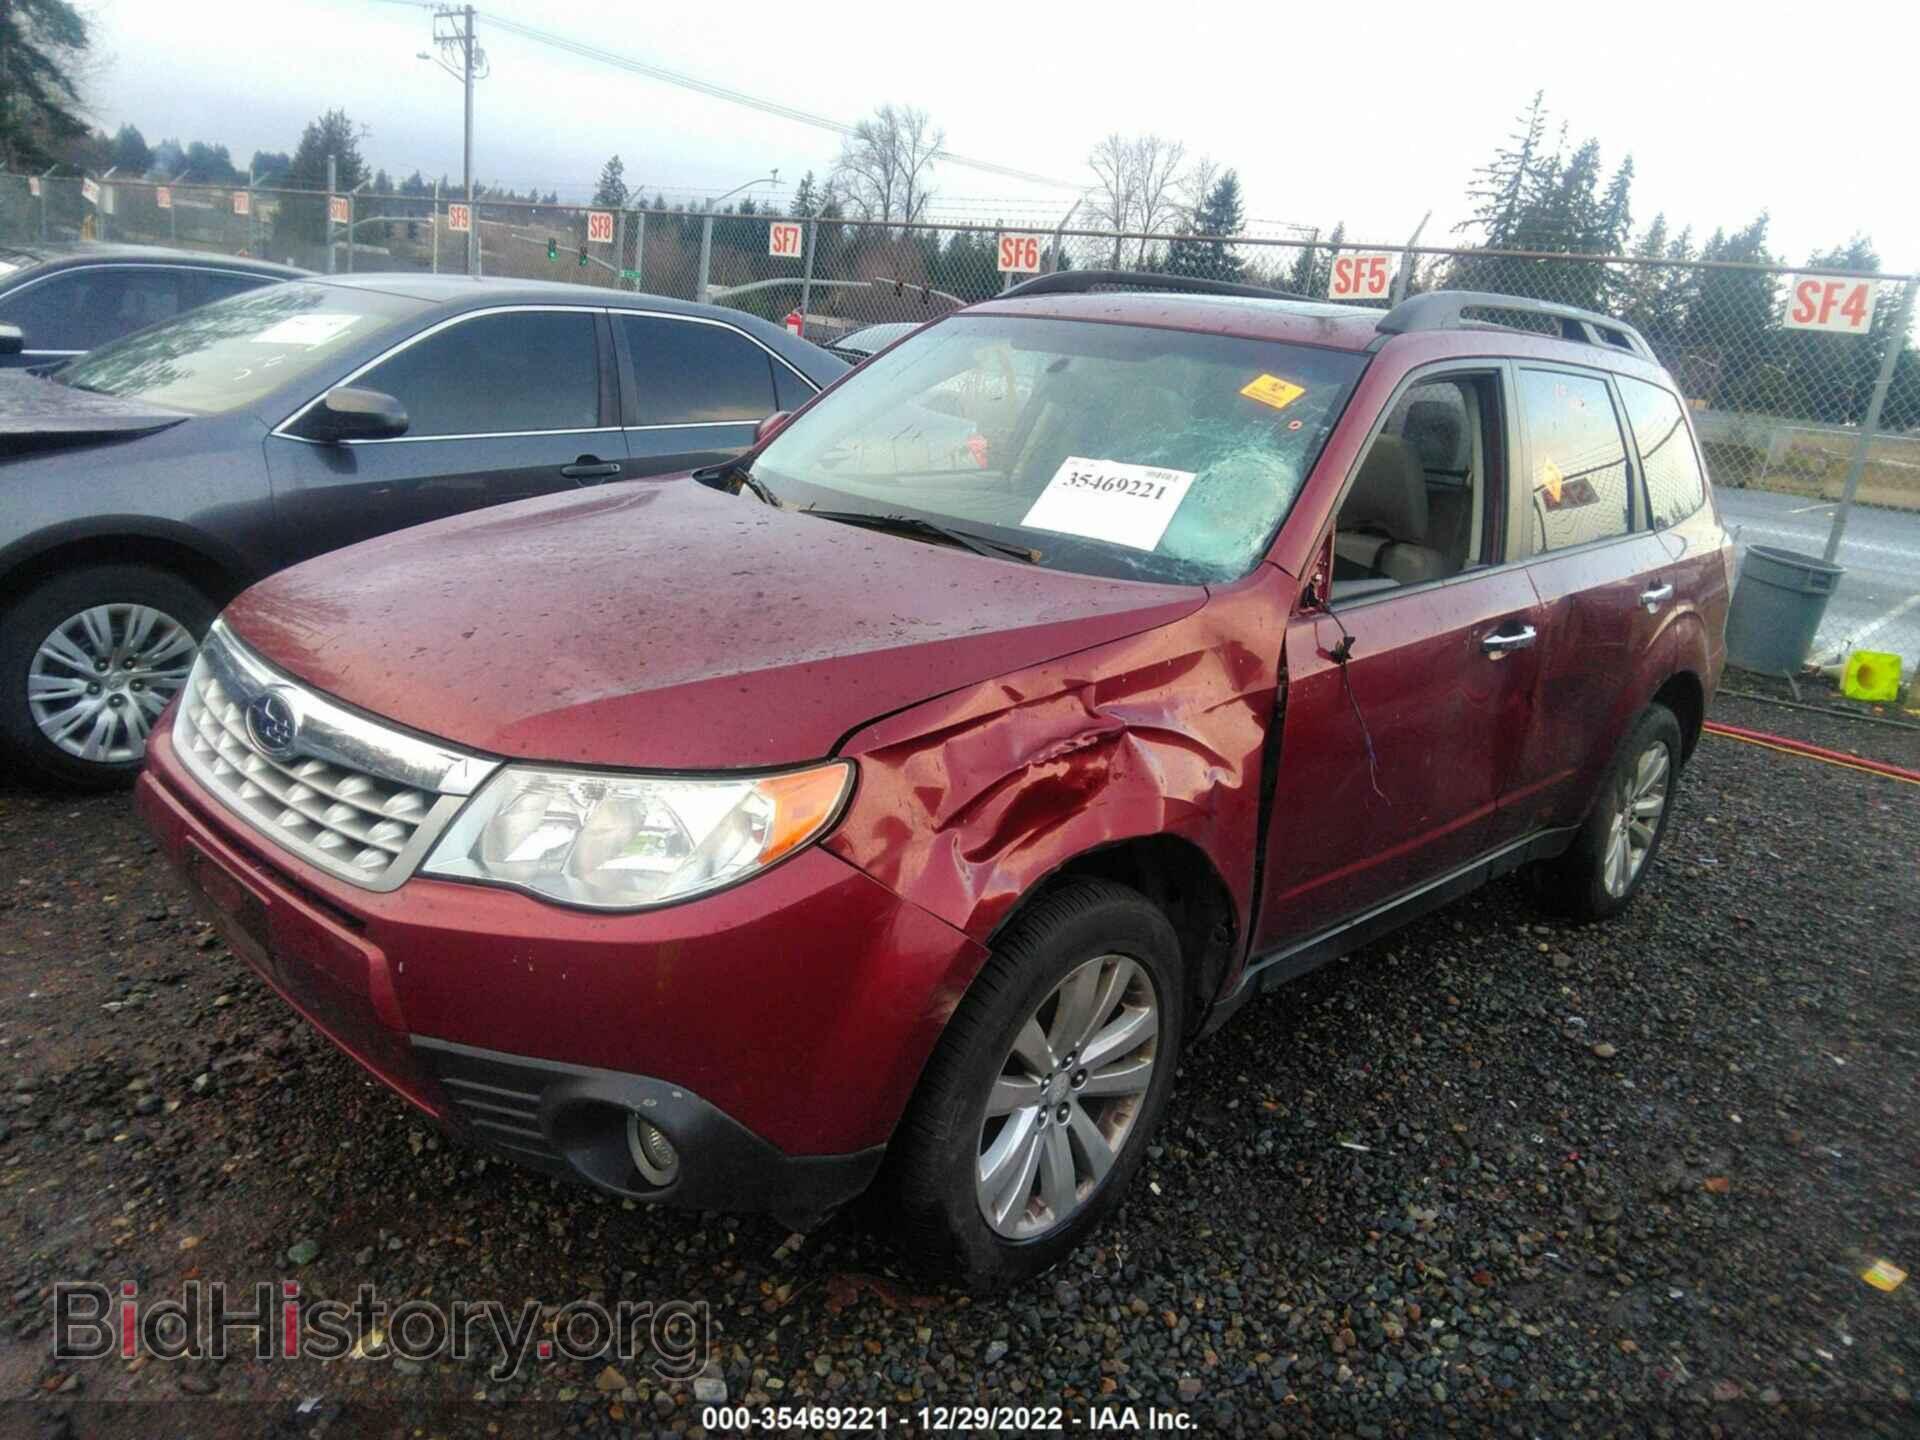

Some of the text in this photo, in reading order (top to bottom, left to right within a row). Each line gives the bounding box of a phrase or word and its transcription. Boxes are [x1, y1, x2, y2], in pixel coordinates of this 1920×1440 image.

[450, 208, 468, 226] SF9
[590, 217, 611, 238] SF8
[773, 226, 798, 253] SF7
[1001, 238, 1037, 267] SF6
[1334, 257, 1388, 295] SF5
[1793, 280, 1868, 325] SF4
[1063, 471, 1168, 500] 35469221
